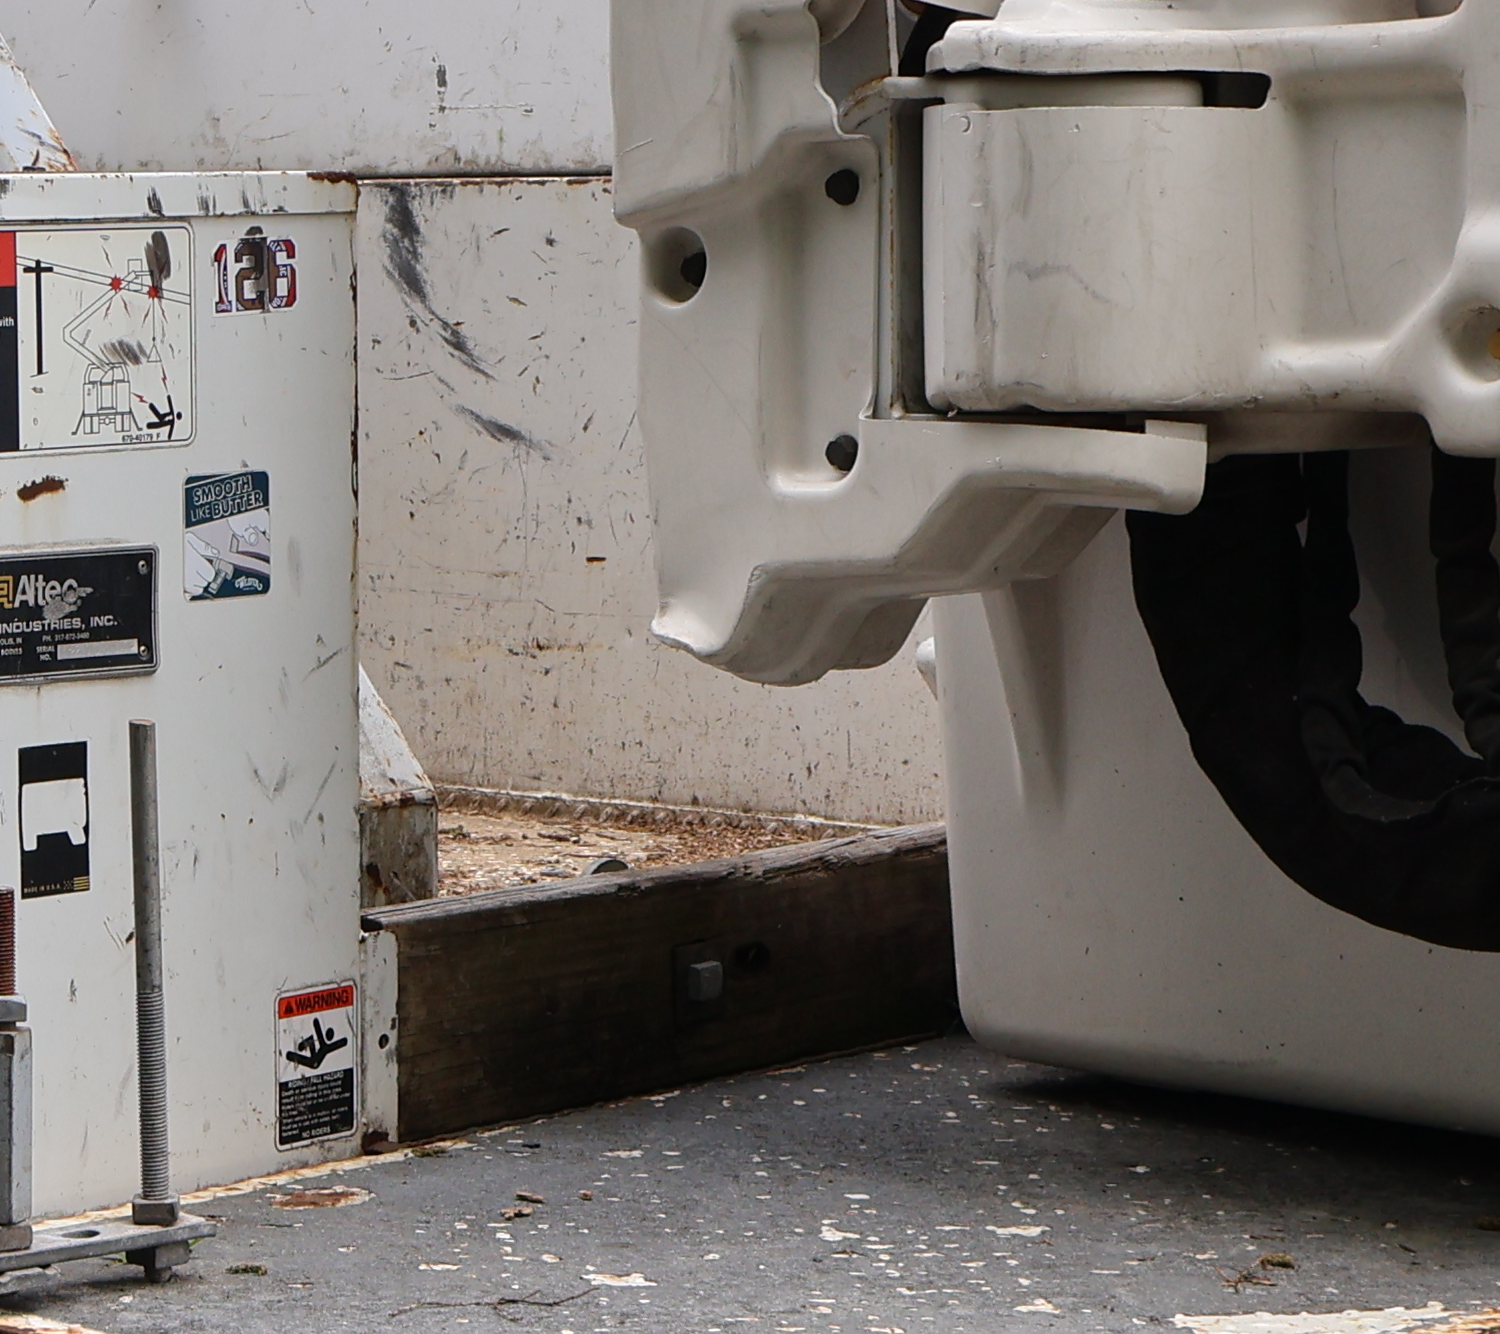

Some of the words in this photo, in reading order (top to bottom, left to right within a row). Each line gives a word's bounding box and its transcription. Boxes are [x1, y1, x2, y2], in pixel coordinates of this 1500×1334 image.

[213, 238, 297, 314] 126
[193, 474, 252, 505] SMOOTH
[190, 505, 211, 521] LIKE
[211, 490, 263, 519] BUTTER
[90, 615, 117, 628] INC.
[295, 990, 350, 1012] WARNING
